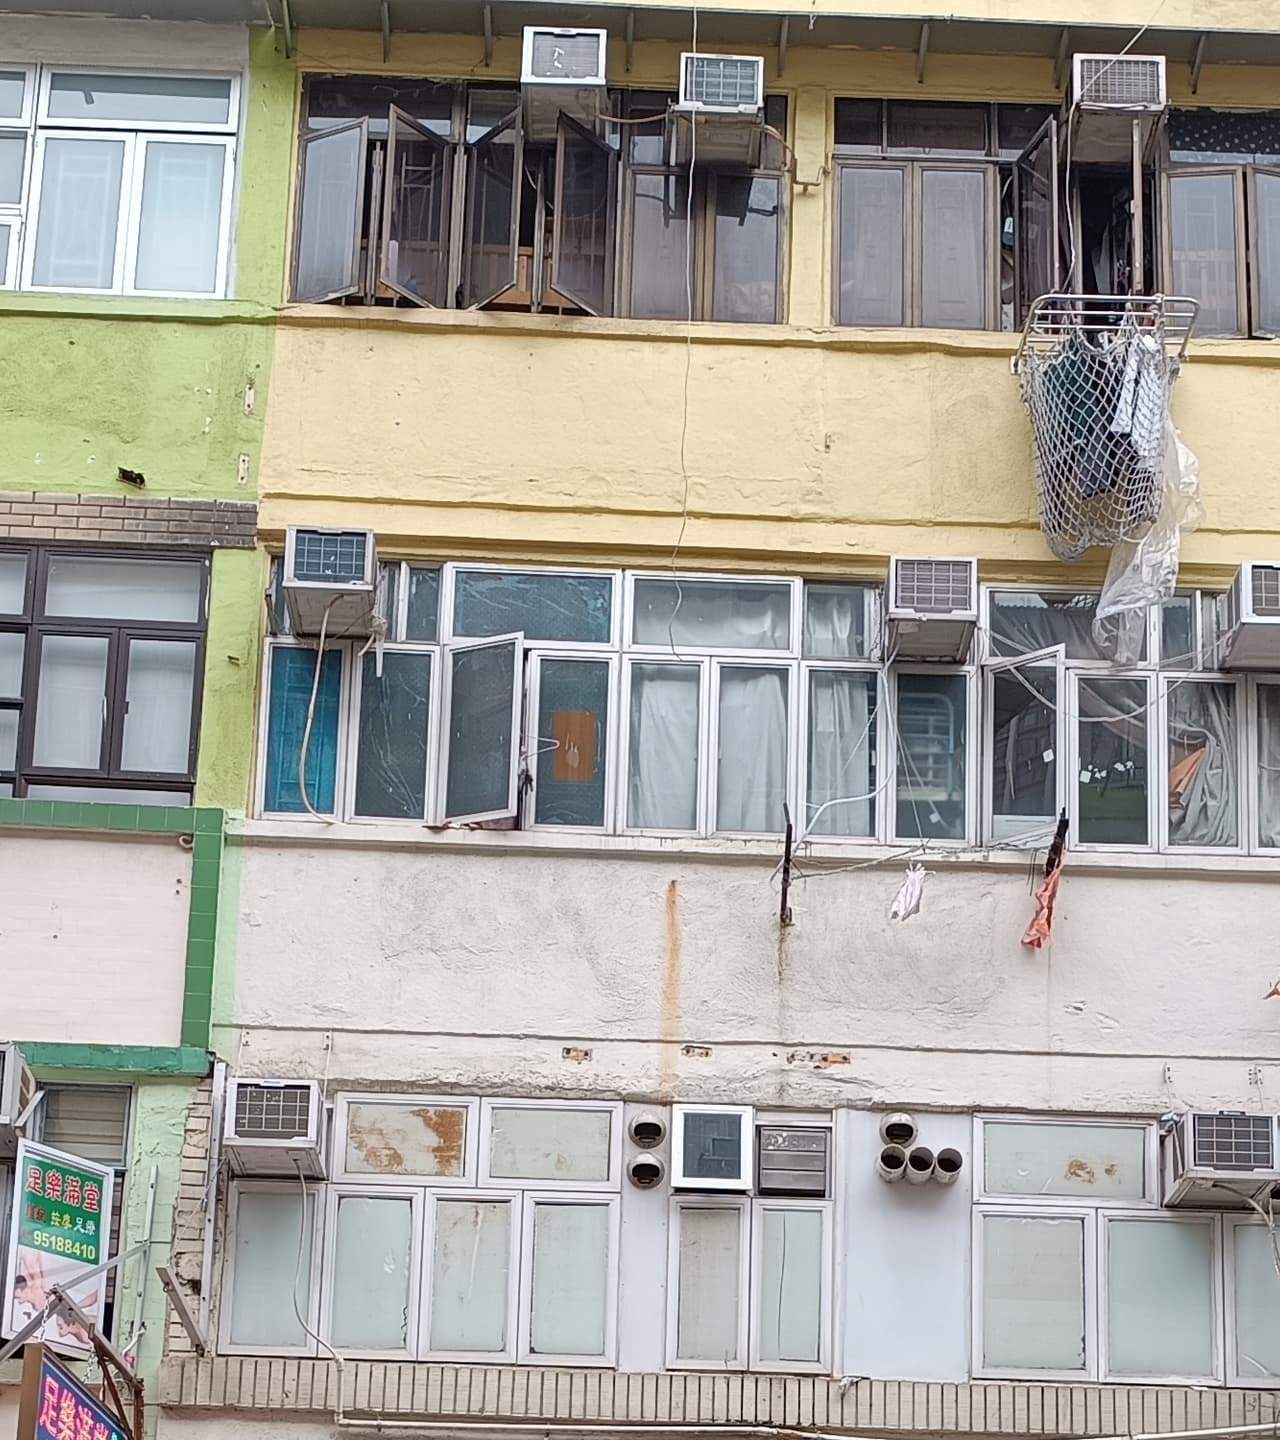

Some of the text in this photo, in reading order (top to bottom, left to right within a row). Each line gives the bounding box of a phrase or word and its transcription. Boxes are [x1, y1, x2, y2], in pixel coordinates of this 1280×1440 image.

[24, 1166, 100, 1213] 足樂滿堂
[33, 1229, 97, 1260] 95188410
